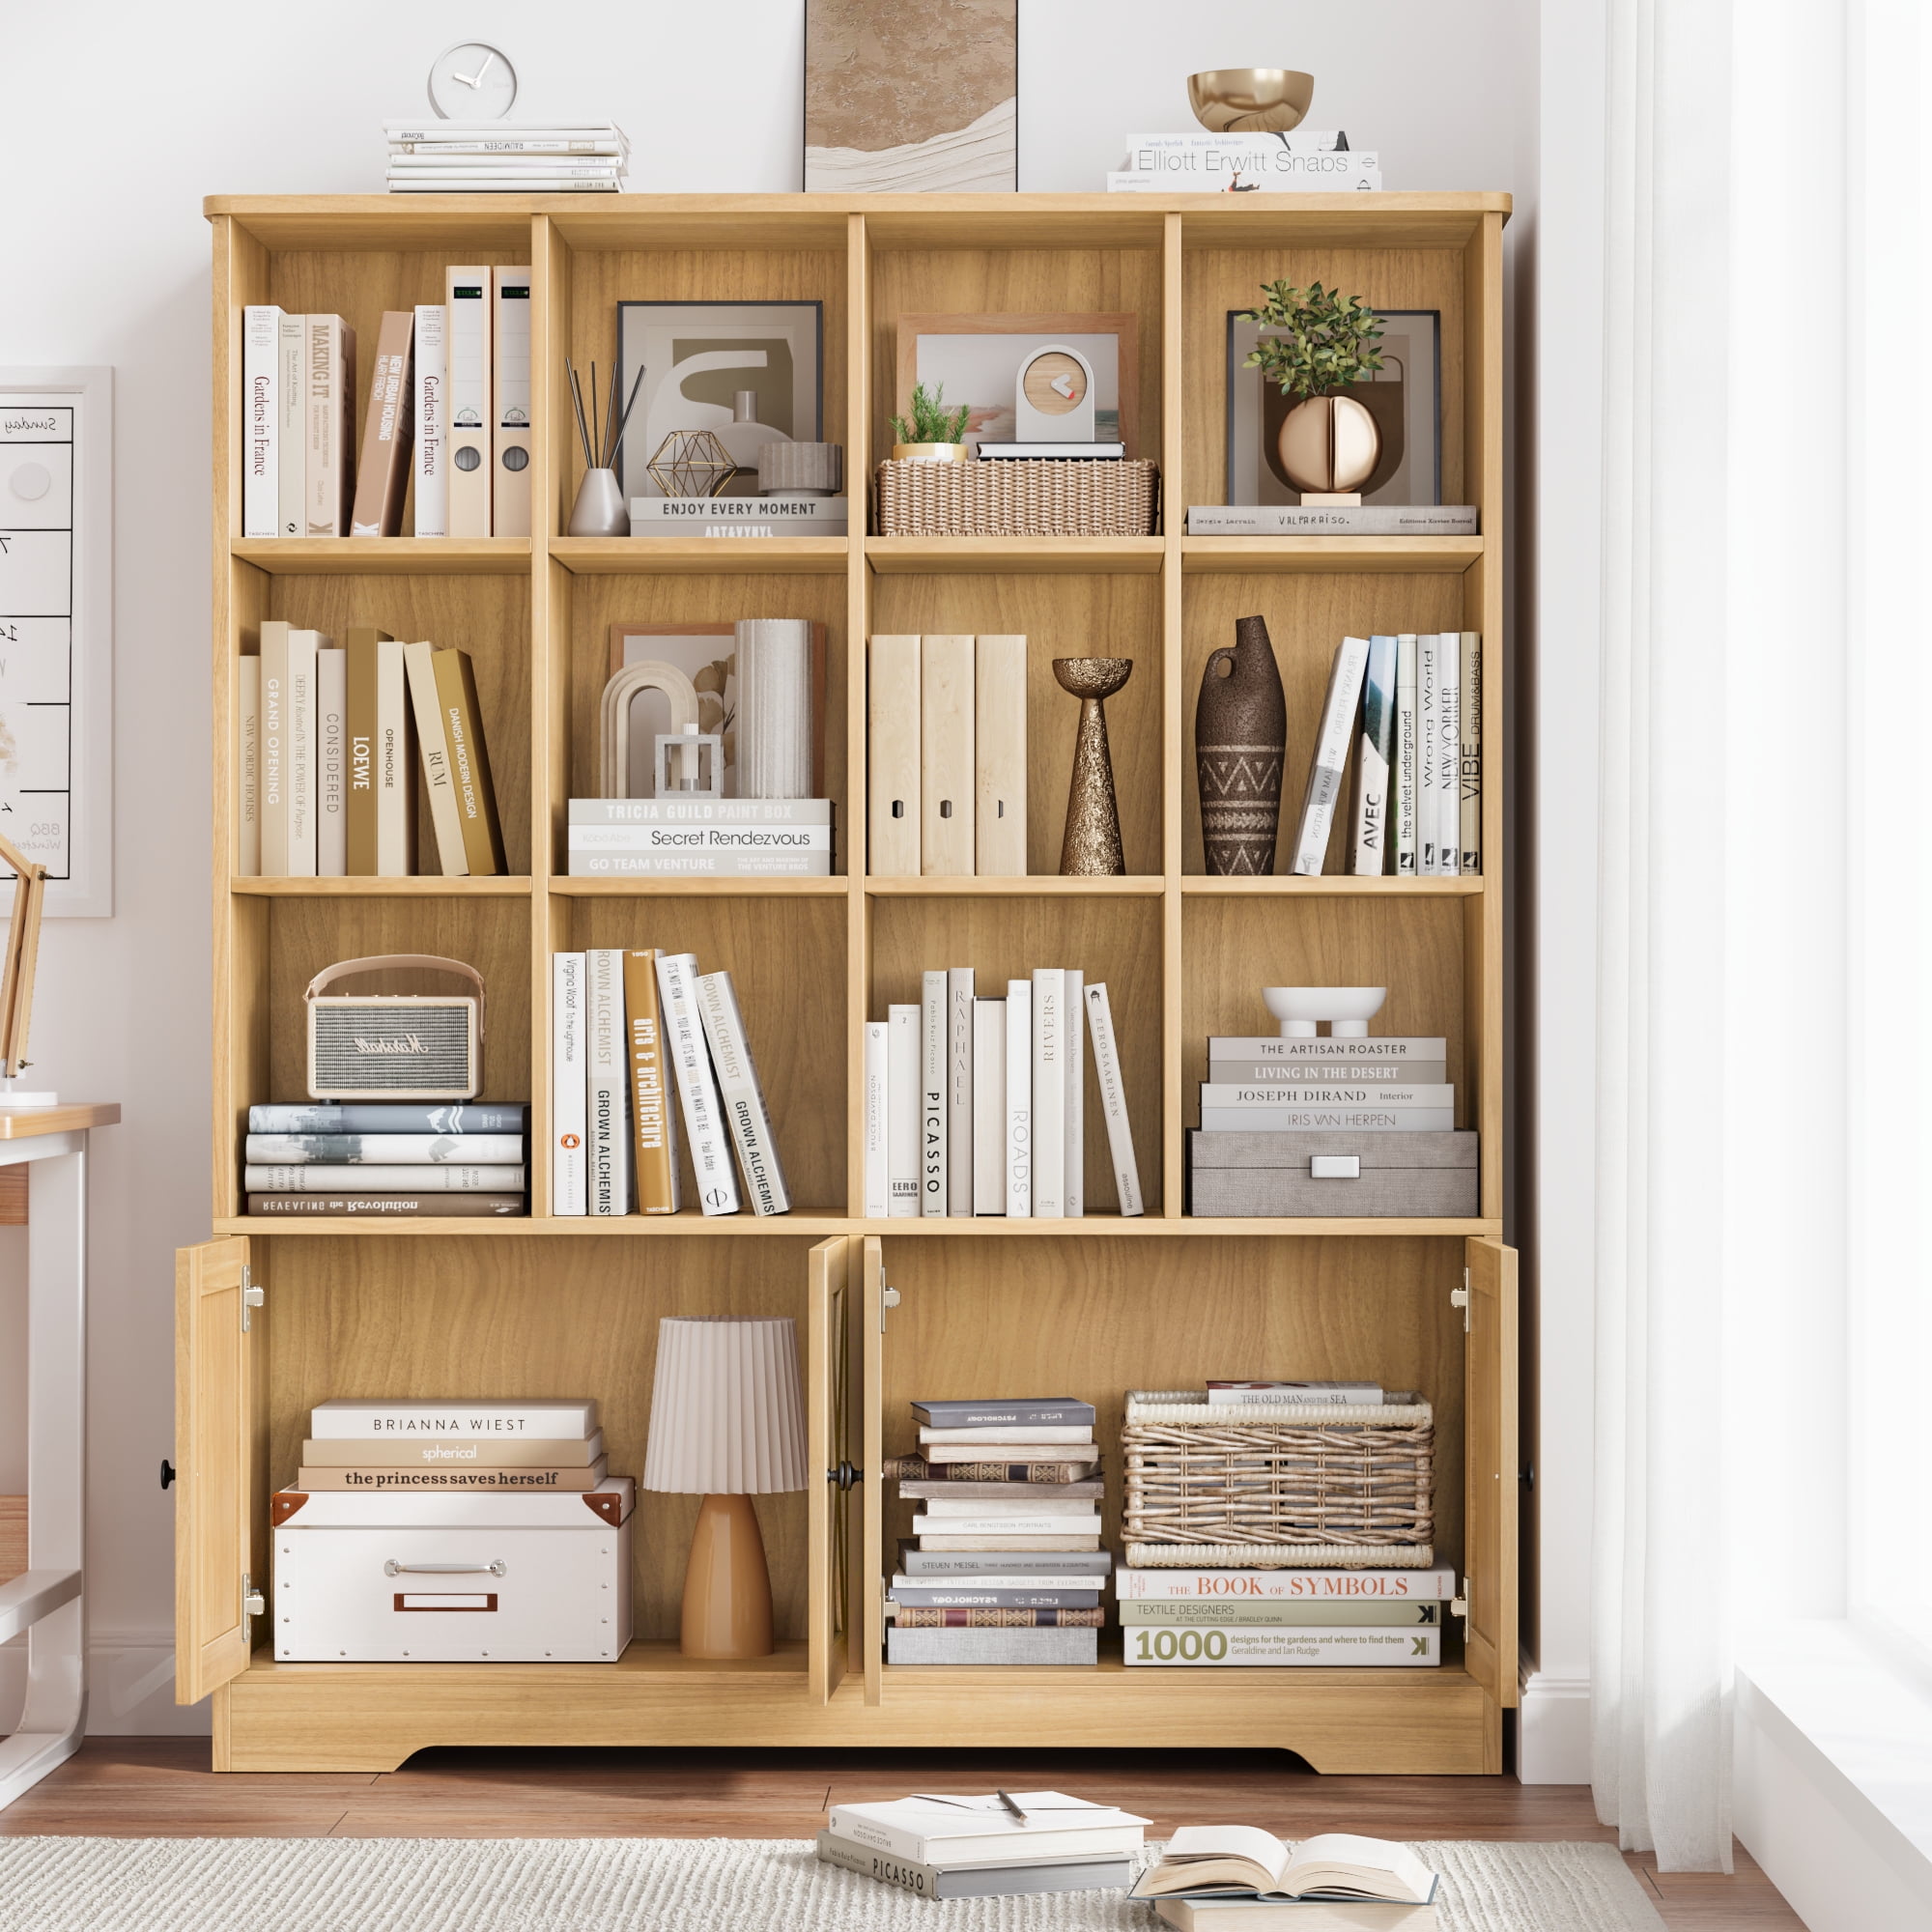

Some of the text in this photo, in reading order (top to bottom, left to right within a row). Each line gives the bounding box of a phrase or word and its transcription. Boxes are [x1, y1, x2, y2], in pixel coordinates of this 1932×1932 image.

[484, 141, 524, 151] RAUMIDEEN
[1139, 151, 1348, 172] Elliott Erwitt Snaps
[312, 325, 329, 398] MAKING IT
[379, 355, 402, 440] NEW URBAN HOUSING
[254, 376, 270, 475] Gardens in France
[424, 376, 440, 475] Gardens in France
[663, 503, 816, 515] ENJOY EVERY MOMENT
[296, 674, 305, 704] DEEPLY
[1424, 651, 1435, 788] Wrong World
[1463, 651, 1481, 801] VIBE DRUM&BASS
[269, 679, 278, 805] GRAND OPENING
[296, 745, 305, 760] THE
[1441, 687, 1459, 790] NEW YORKER
[246, 716, 255, 822] NEW NORDIC HOUSES
[296, 763, 305, 792] POWER
[327, 713, 338, 813] CONSIDERED
[354, 736, 369, 790] LOEWE
[428, 751, 446, 786] RUM
[449, 708, 477, 818] DANISH MODERN DESIGN
[1402, 711, 1413, 838] the velvet underground
[296, 796, 305, 808] OF
[607, 806, 792, 819] TRICIA GUILD PAINT BOX
[651, 831, 810, 845] Secret Rendezvous
[1363, 793, 1380, 850] AVEC
[589, 859, 715, 869] GO TEAM VENTURE
[564, 959, 577, 986] Virginia
[598, 994, 611, 1066] ALCHEMIST
[667, 962, 707, 1122] IT'S NOT HOW YOU IT'S HOW YOU WANT TO
[1043, 995, 1054, 1062] RIVERS
[715, 1015, 740, 1080] ALCHEMIST
[955, 990, 966, 1105] RAPHAEL
[1262, 1045, 1406, 1054] THE ARTISAN ROASTER
[634, 1018, 663, 1149] arts architecture
[1095, 1018, 1120, 1117] EERO SAARINEN
[1255, 1067, 1399, 1079] LIVING IN THE DESERT
[1236, 1091, 1413, 1102] JOSEPH DIRAND Interior
[598, 1091, 611, 1141] GROWN
[735, 1100, 757, 1148] GROWN
[1289, 1115, 1396, 1125] IRIS VAN HERPEN
[701, 1141, 717, 1172] Paul Arden
[927, 1093, 940, 1192] PICASSO
[1013, 1111, 1028, 1192] ROADS
[1122, 1173, 1132, 1209] assouline
[1240, 1395, 1348, 1405] THE OLD MAN SEA
[374, 1419, 526, 1431] BRIANNA WIEST
[423, 1445, 477, 1463] spherical
[345, 1472, 558, 1488] the princess saves herself
[1168, 1577, 1408, 1596] THE BOOK OF SYMBOLS
[1137, 1605, 1235, 1615] TEXTILE DESIGNERS
[1136, 1631, 1227, 1661] 1000
[1231, 1634, 1260, 1645] designs
[1261, 1634, 1271, 1644] for
[1273, 1634, 1286, 1644] the
[1287, 1634, 1317, 1645] gardens
[1319, 1634, 1332, 1644] and
[1334, 1634, 1357, 1644] where
[1369, 1634, 1383, 1644] find
[1385, 1634, 1405, 1644] them
[1232, 1646, 1321, 1656] Geraldine and Ian Rudge
[873, 1858, 923, 1889] PICASSO
